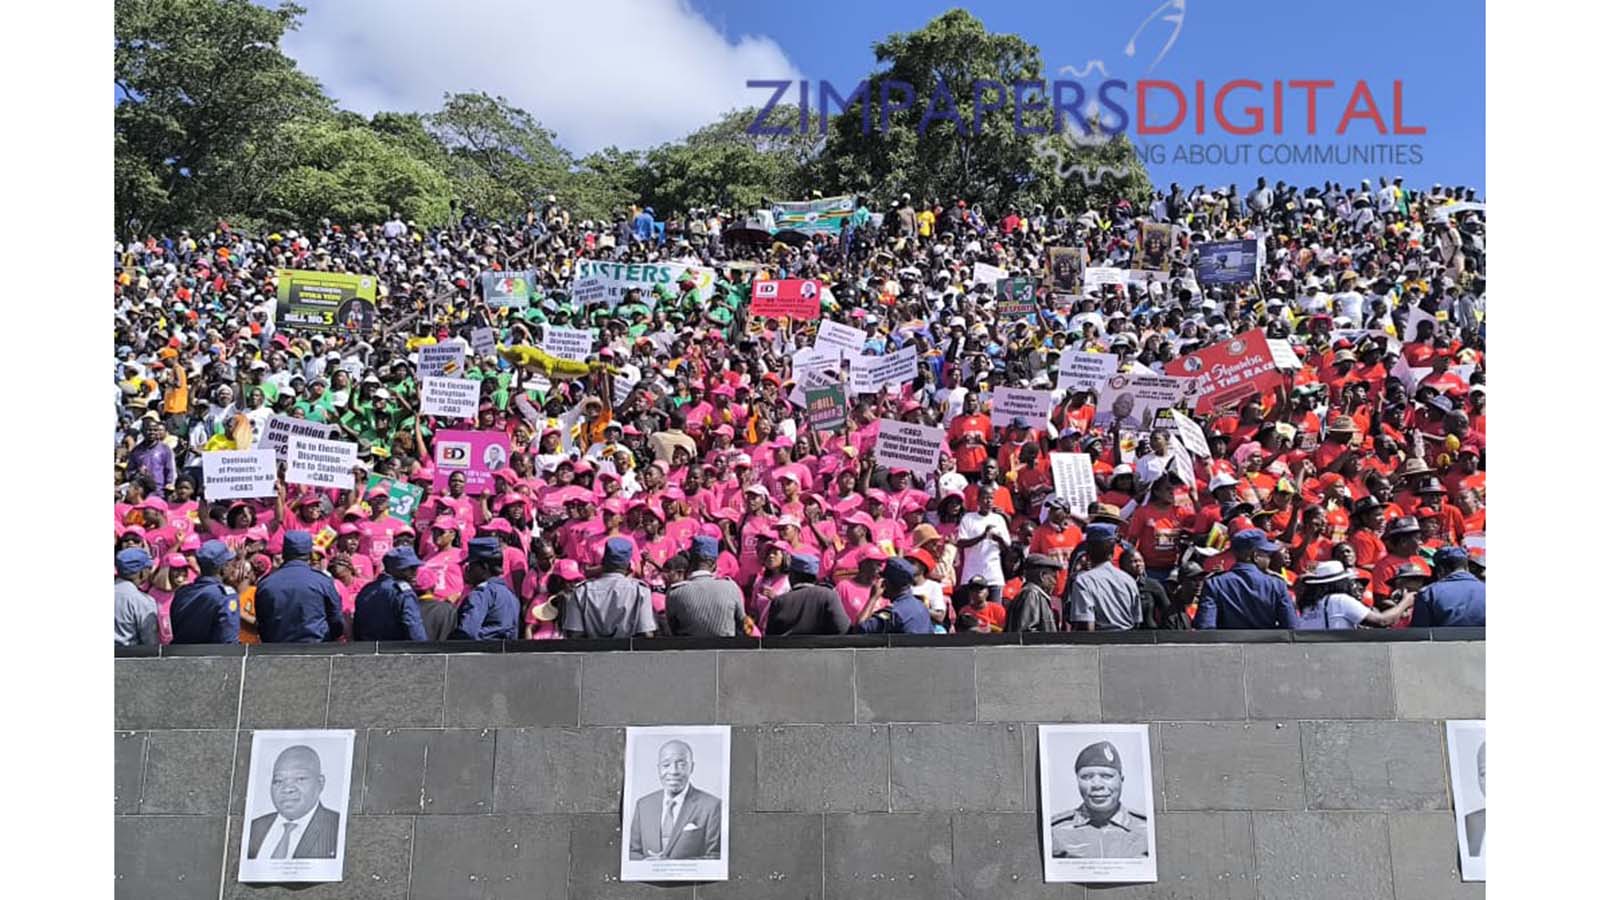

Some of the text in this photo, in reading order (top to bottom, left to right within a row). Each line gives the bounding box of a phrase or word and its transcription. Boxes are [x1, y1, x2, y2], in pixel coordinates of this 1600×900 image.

[580, 262, 672, 283] SISTERS
[270, 418, 326, 439] One nation
[268, 432, 288, 443] one
[296, 441, 306, 449] No
[318, 444, 350, 455] Election
[443, 447, 465, 460] ED
[307, 462, 316, 470] to
